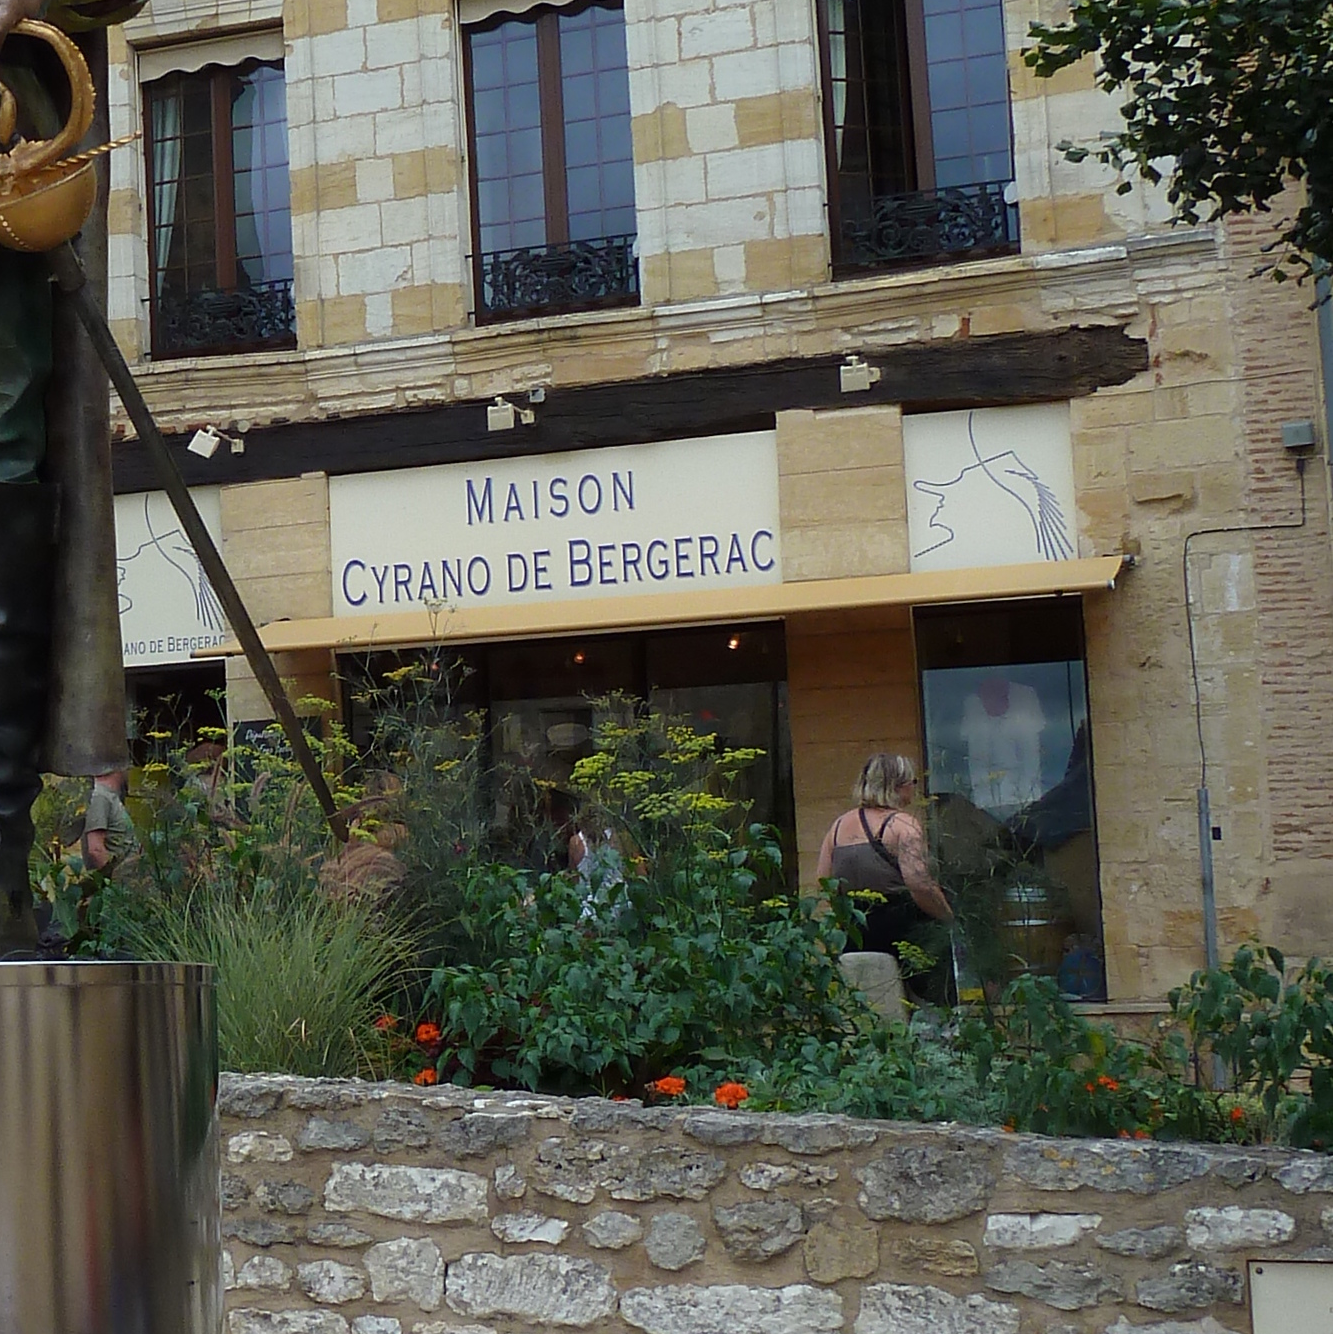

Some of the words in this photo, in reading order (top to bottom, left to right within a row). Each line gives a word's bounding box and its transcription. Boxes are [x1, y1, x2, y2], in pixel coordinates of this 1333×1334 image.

[465, 470, 636, 526] MAISON
[342, 549, 491, 607] CYRANO
[506, 548, 553, 593] DE
[567, 529, 776, 588] BERGERAC
[149, 640, 164, 653] DE
